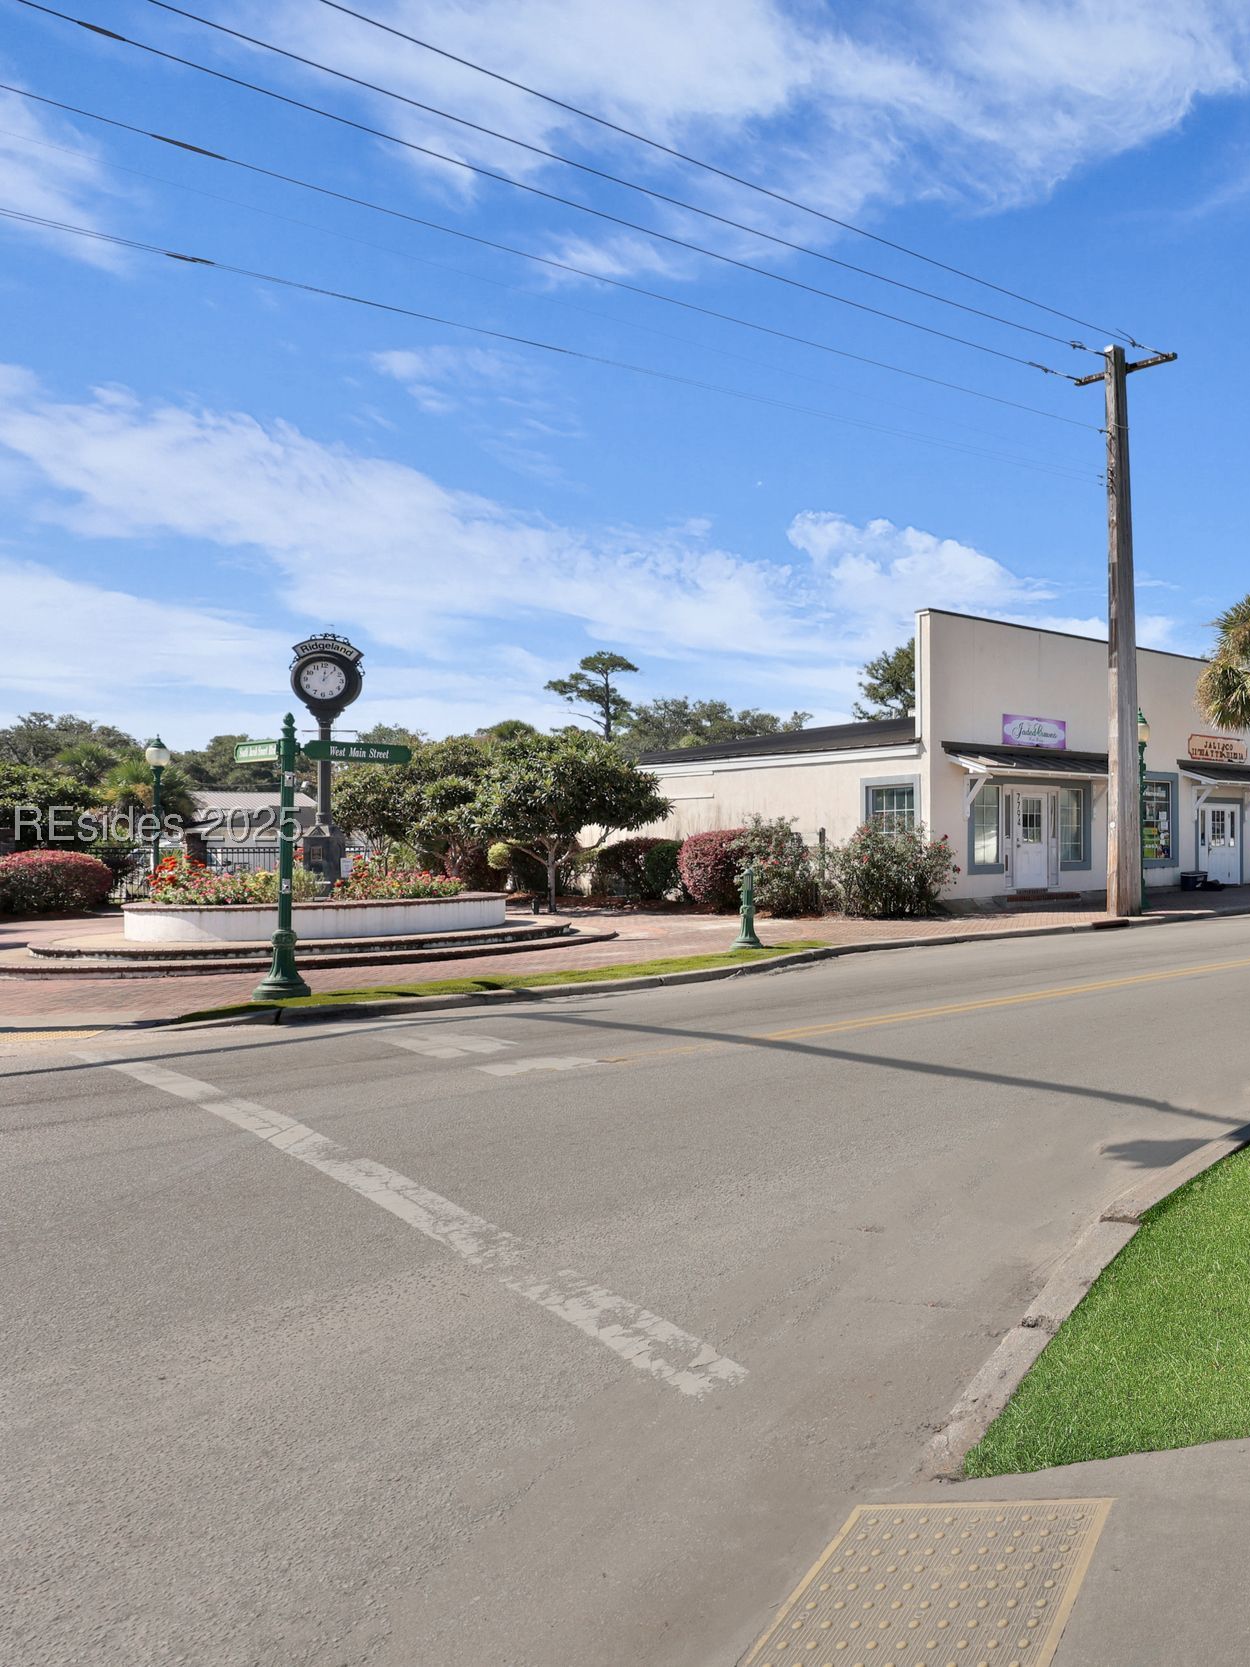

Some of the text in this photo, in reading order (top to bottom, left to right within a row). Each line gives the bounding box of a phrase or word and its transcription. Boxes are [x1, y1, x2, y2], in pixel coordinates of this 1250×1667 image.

[300, 642, 354, 657] Ridgeland
[329, 745, 390, 759] West Main Street
